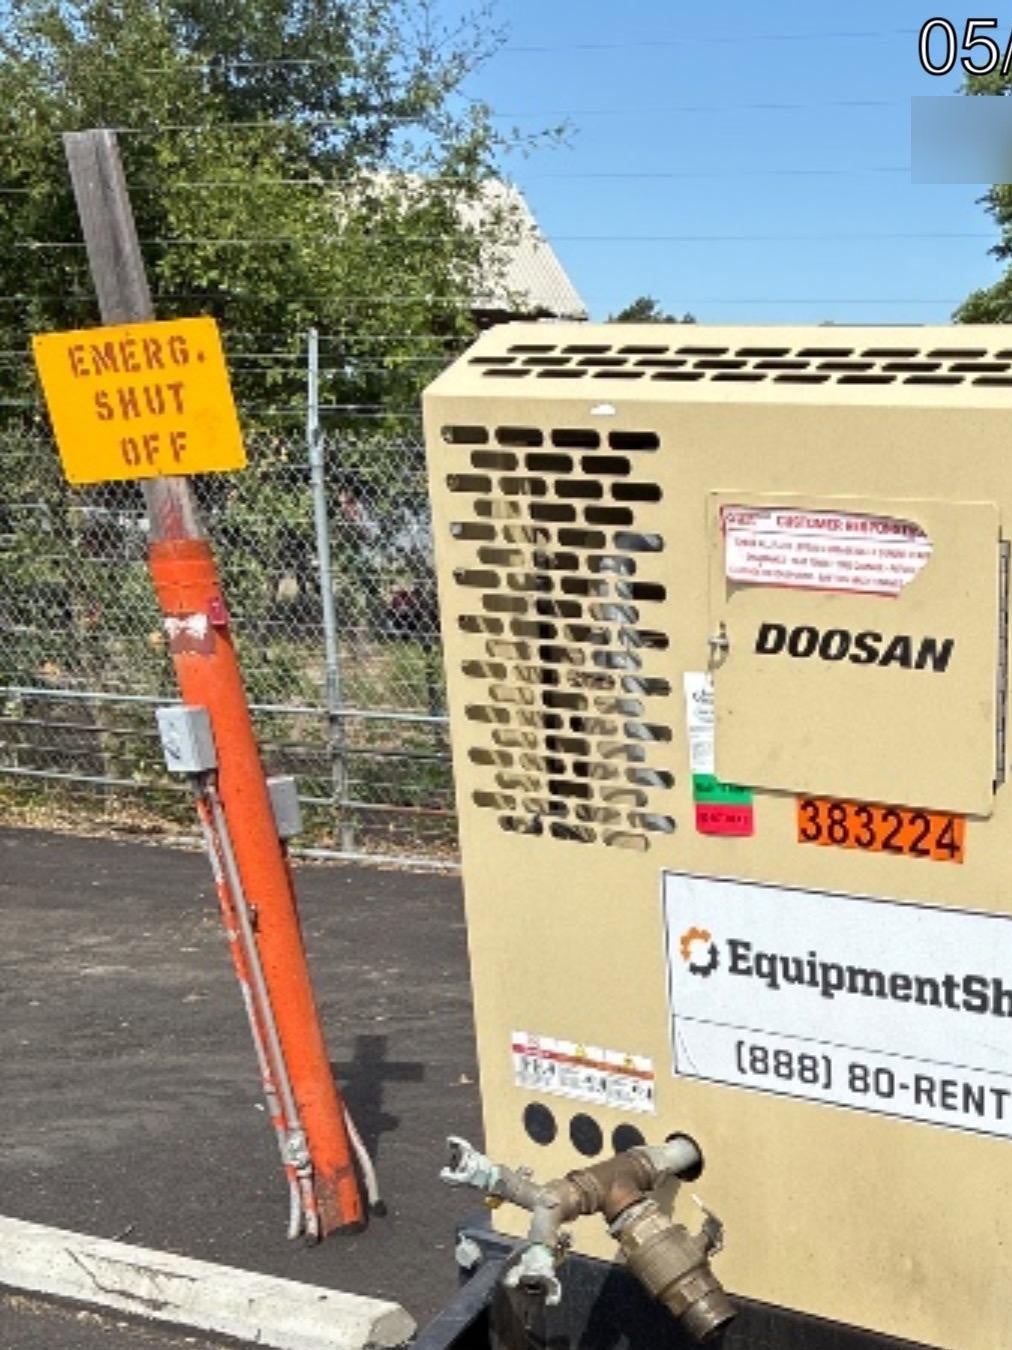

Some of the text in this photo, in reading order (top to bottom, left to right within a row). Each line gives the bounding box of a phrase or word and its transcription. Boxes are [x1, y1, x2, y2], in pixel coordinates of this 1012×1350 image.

[68, 336, 205, 378] EMERG.
[94, 381, 184, 420] SHUT
[121, 431, 187, 466] OFF
[755, 623, 955, 672] DOOSAN
[800, 801, 960, 858] 383224
[735, 1040, 833, 1089] (888)
